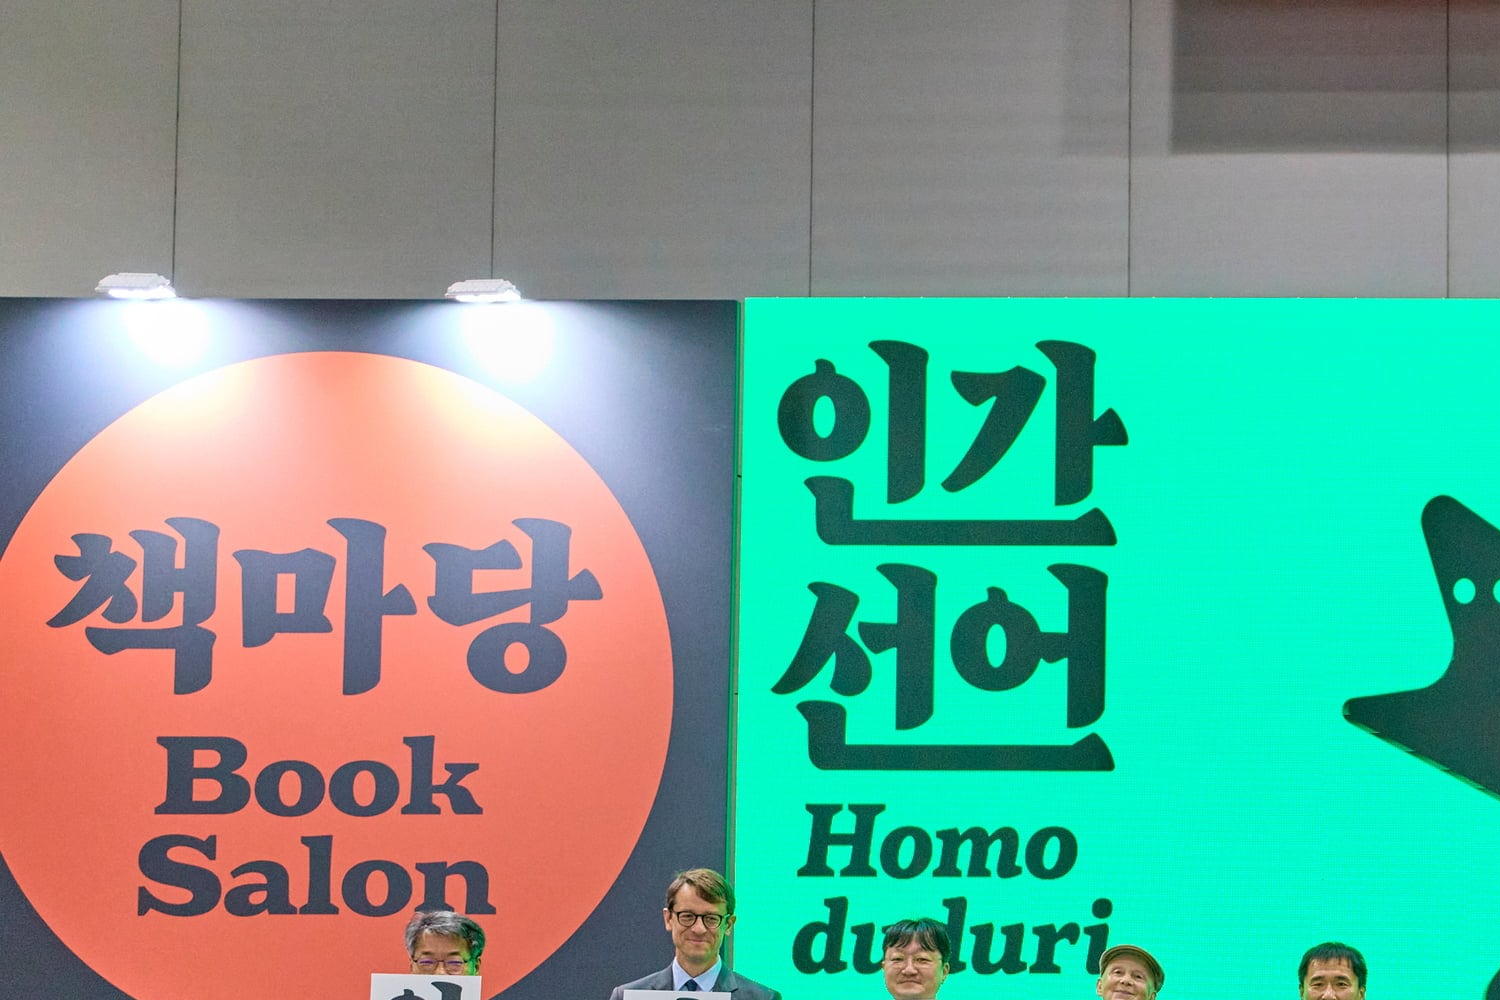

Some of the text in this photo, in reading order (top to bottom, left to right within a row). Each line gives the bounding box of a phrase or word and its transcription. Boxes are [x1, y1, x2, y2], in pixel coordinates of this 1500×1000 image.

[46, 517, 604, 696] 책마당
[154, 735, 484, 818] Book
[137, 833, 497, 917] Salon
[797, 803, 1078, 880] Homo
